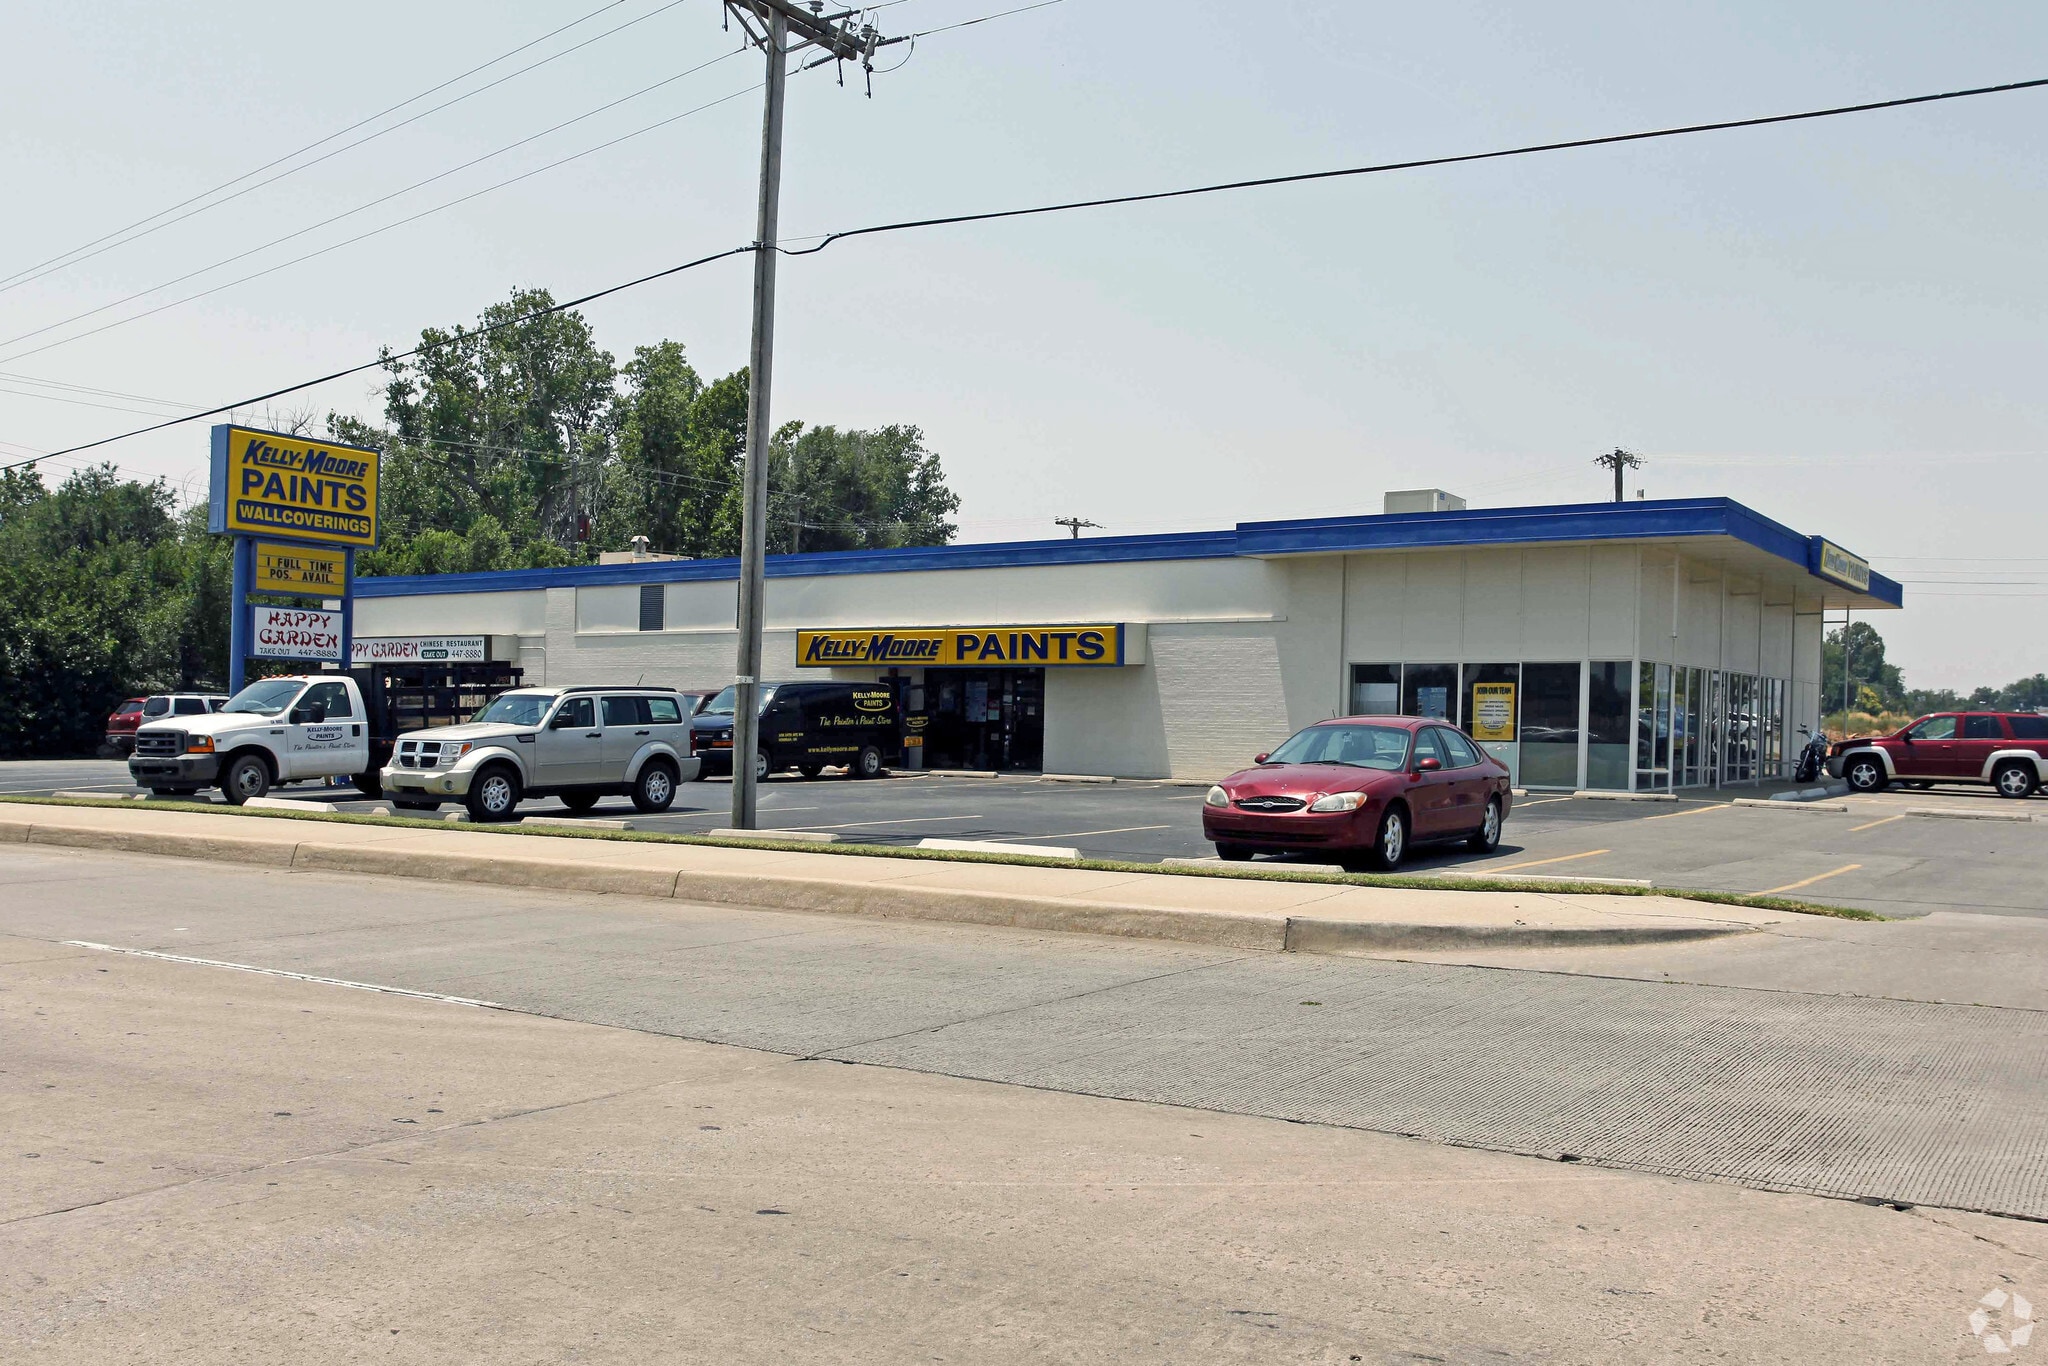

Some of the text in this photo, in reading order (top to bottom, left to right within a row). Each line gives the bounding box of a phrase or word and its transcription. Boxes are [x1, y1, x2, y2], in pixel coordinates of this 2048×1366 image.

[242, 439, 369, 479] KELLY-MOORE
[241, 468, 367, 511] PAINTS
[239, 504, 369, 534] WALLCOVERINGS
[277, 557, 301, 569] FULL
[310, 560, 334, 572] TIME
[269, 568, 334, 584] POS. AVAIL.
[267, 610, 331, 629] HAPPY
[259, 628, 338, 649] GARDEN
[419, 639, 483, 648] CHINESE RESTAURANT
[956, 631, 1106, 661] PAINTS
[259, 647, 338, 657] TAKE OUT 447-8880
[371, 642, 418, 659] GARDEN
[451, 649, 482, 659] 447-8880
[805, 634, 944, 662] KELLY-MOORE
[852, 691, 891, 699] KELLY-MOORE
[863, 699, 883, 707] PAINTS
[819, 715, 892, 727] The Painter's Paint Store
